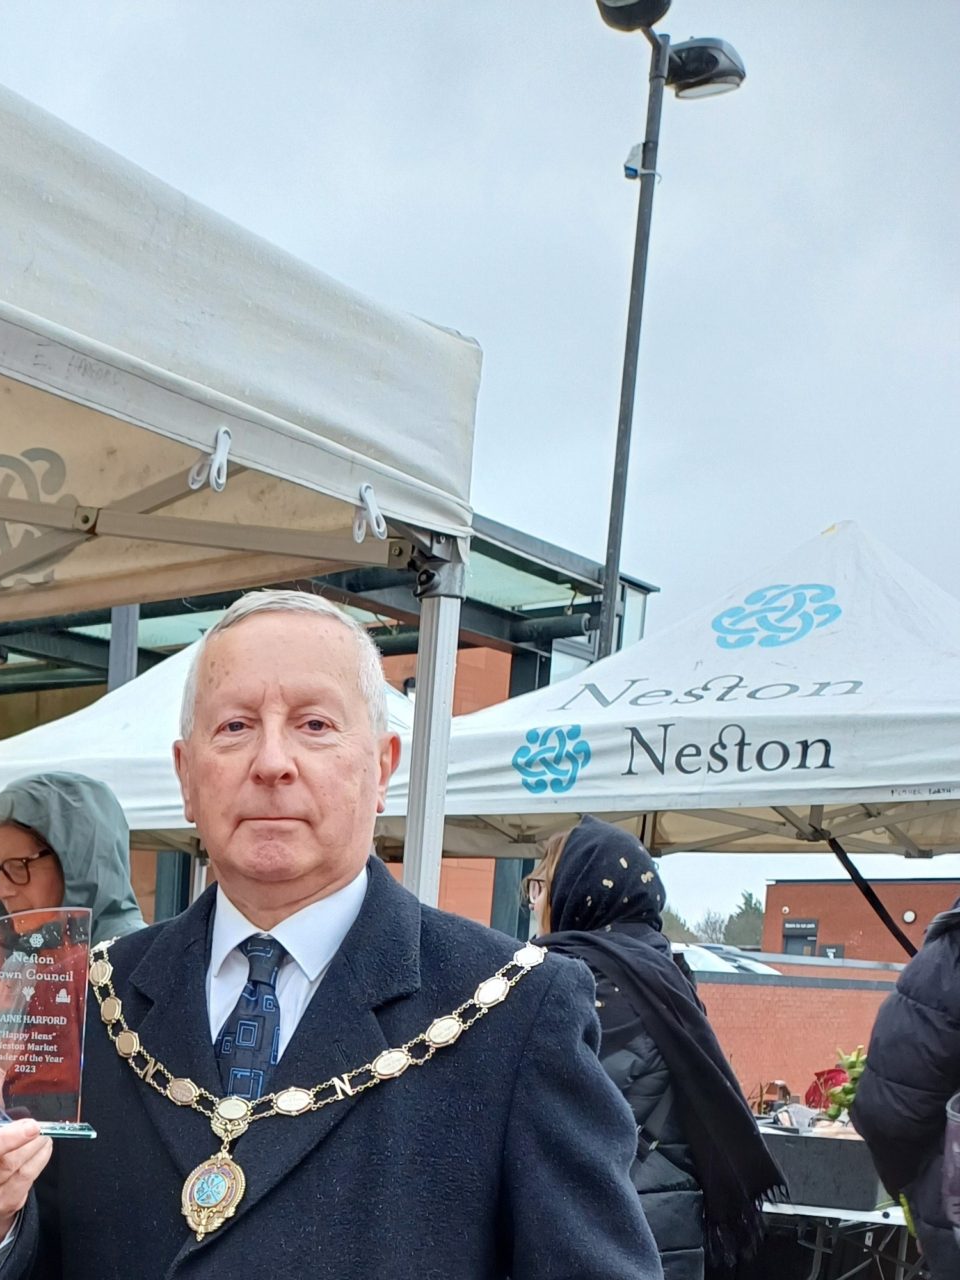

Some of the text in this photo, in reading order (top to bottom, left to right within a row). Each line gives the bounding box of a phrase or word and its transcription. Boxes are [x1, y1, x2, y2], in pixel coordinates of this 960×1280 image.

[549, 674, 863, 711] Neston
[621, 723, 835, 777] Neston
[12, 950, 55, 965] Neston
[26, 968, 74, 982] Council
[23, 1015, 68, 1025] HARFORD
[27, 1042, 58, 1052] Market
[19, 1053, 29, 1061] of
[29, 1054, 44, 1062] the
[44, 1054, 64, 1063] Year
[14, 1064, 37, 1073] 2023
